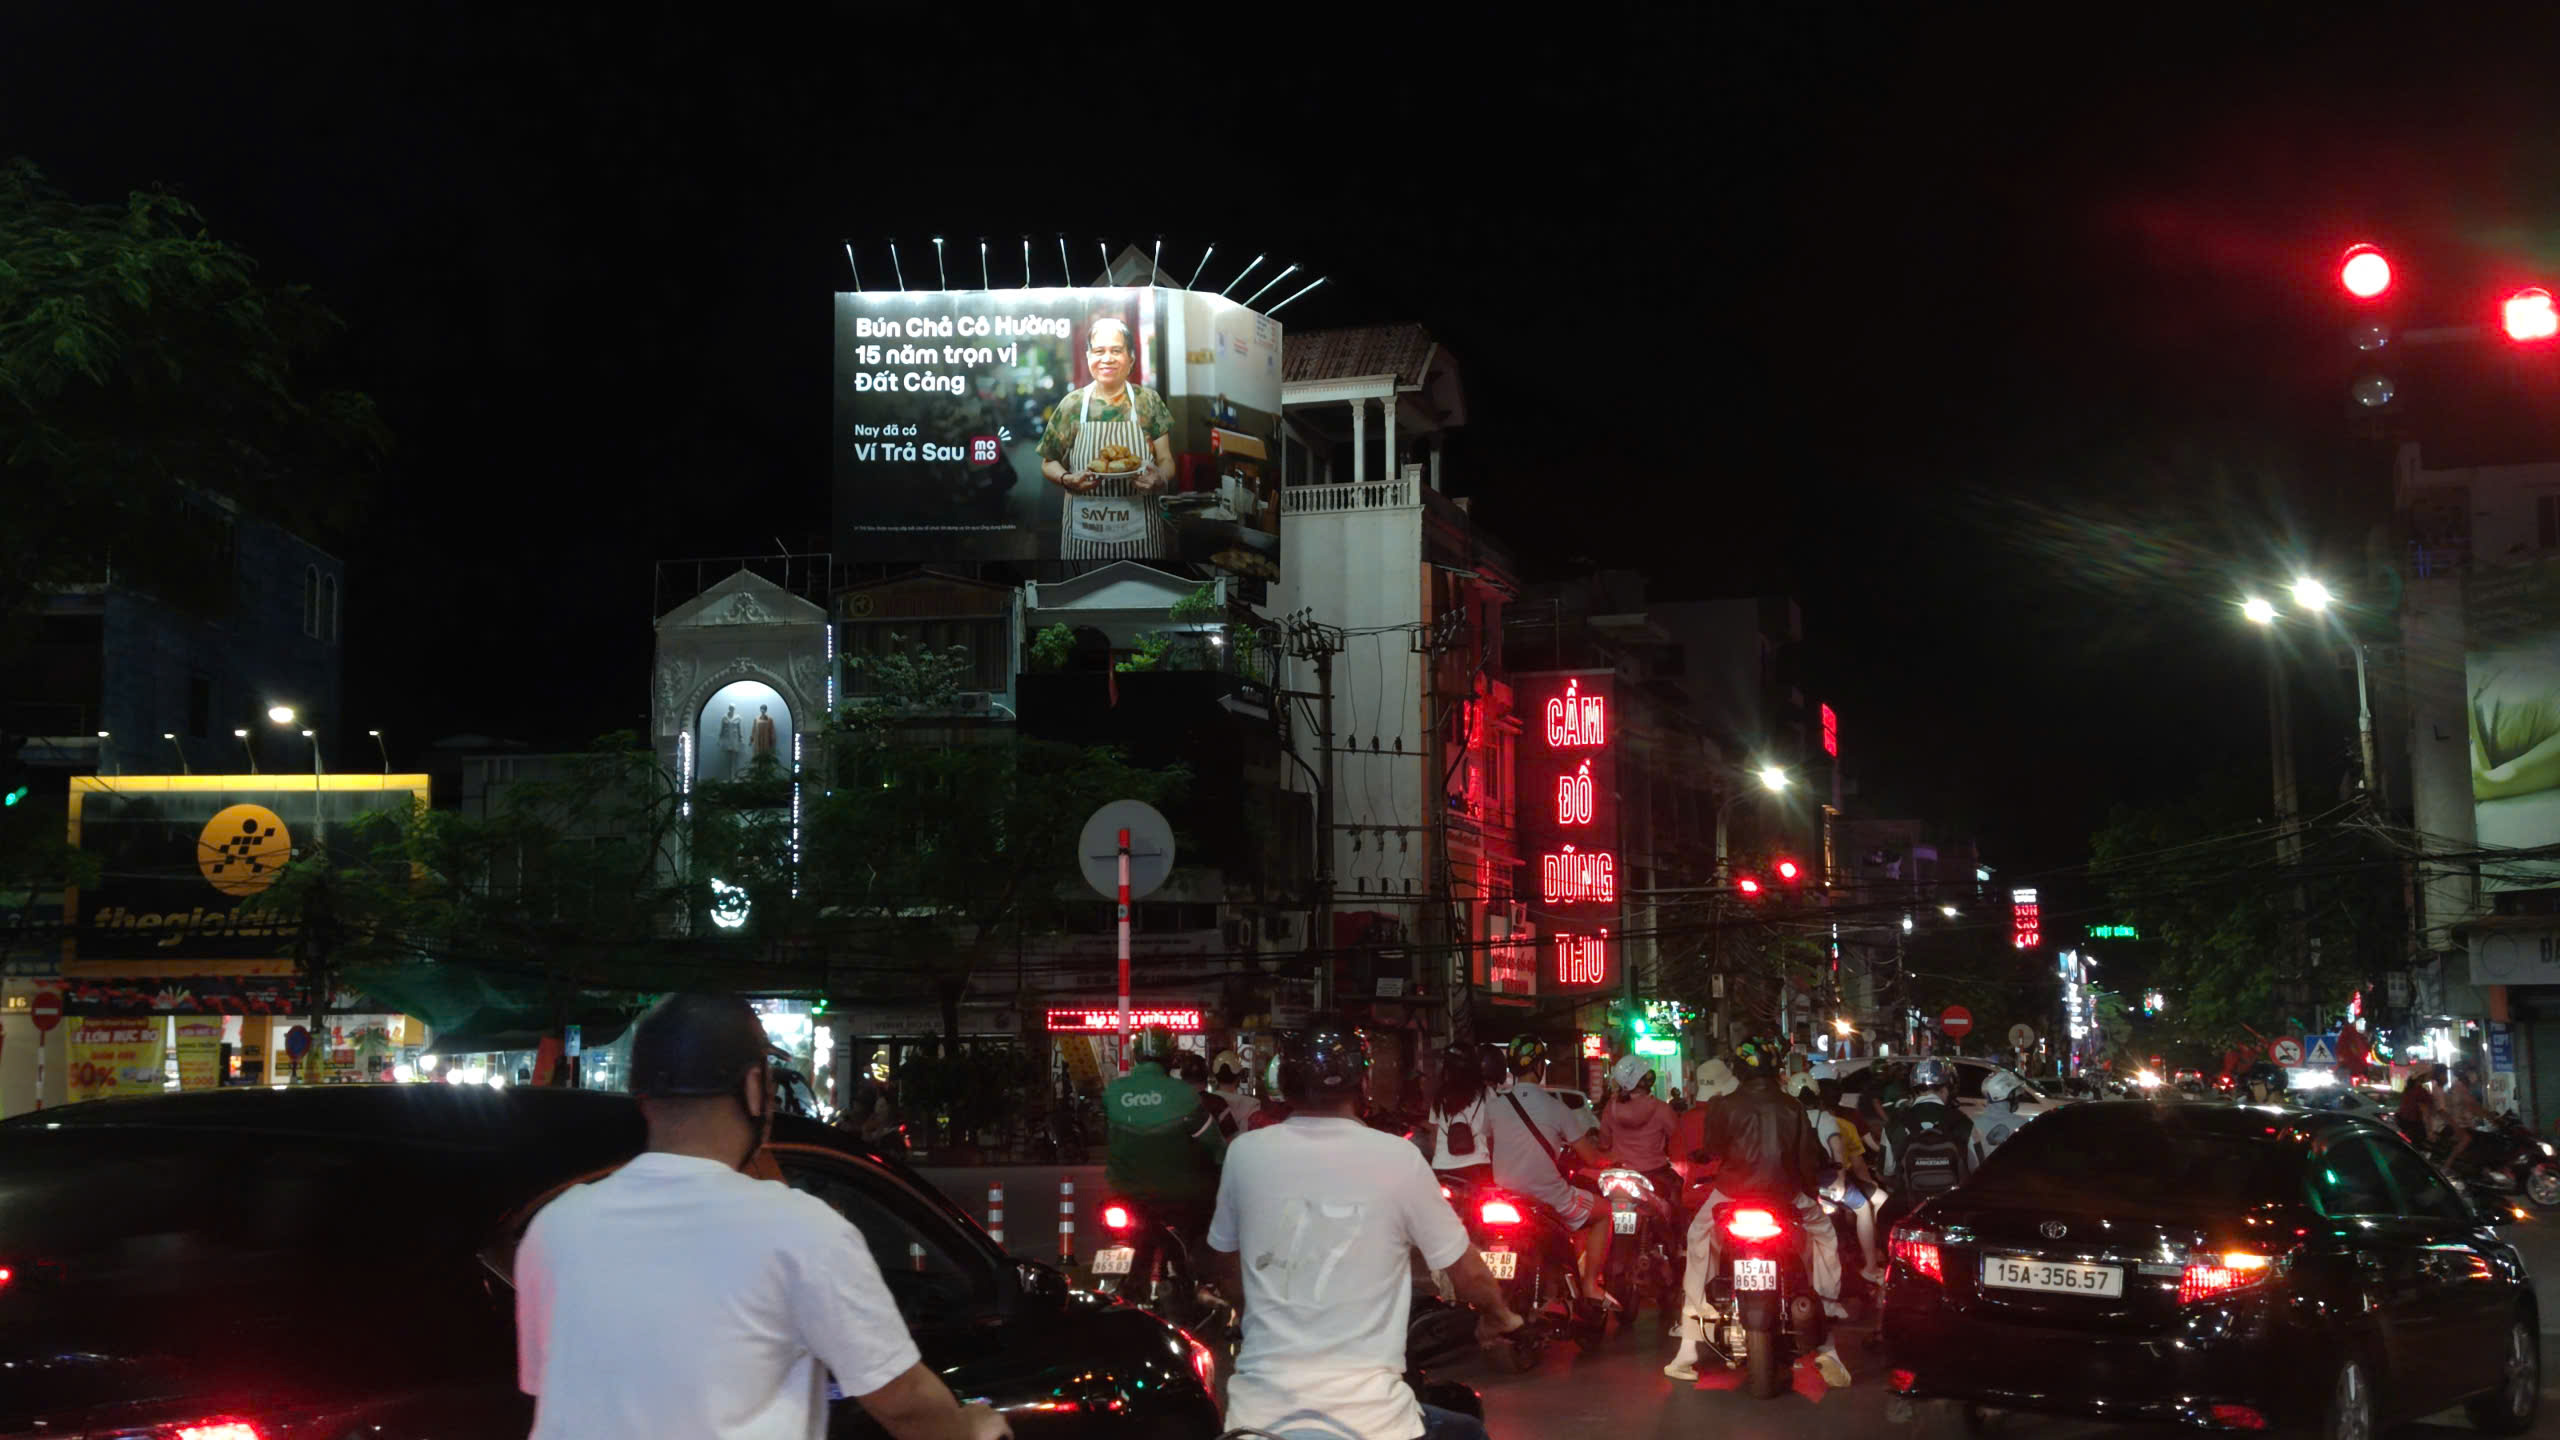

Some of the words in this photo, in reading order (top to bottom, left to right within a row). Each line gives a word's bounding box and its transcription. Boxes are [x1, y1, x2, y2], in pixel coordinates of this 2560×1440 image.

[856, 316, 901, 338] Bún
[905, 315, 953, 338] Chả
[957, 315, 991, 337] Cô
[994, 314, 1071, 339] Hường
[855, 344, 881, 364] 15
[886, 344, 938, 364] năm
[943, 345, 993, 368] trọn
[997, 341, 1018, 367] vị
[854, 370, 899, 392] Đất
[903, 370, 966, 395] Cảng
[854, 424, 879, 438] Nay
[883, 423, 899, 436] đã
[902, 423, 918, 436] có
[854, 442, 877, 461] Ví
[881, 441, 917, 461] Trả
[922, 442, 965, 461] Sau
[1547, 679, 1605, 747] CẦM
[1557, 758, 1593, 825] ĐỒ
[1543, 844, 1614, 904] DŨNG
[8, 997, 26, 1008] 16
[1120, 1090, 1162, 1107] Grab
[1741, 1261, 1771, 1274] 15-AA
[1997, 1262, 2109, 1290] 15A-356.57
